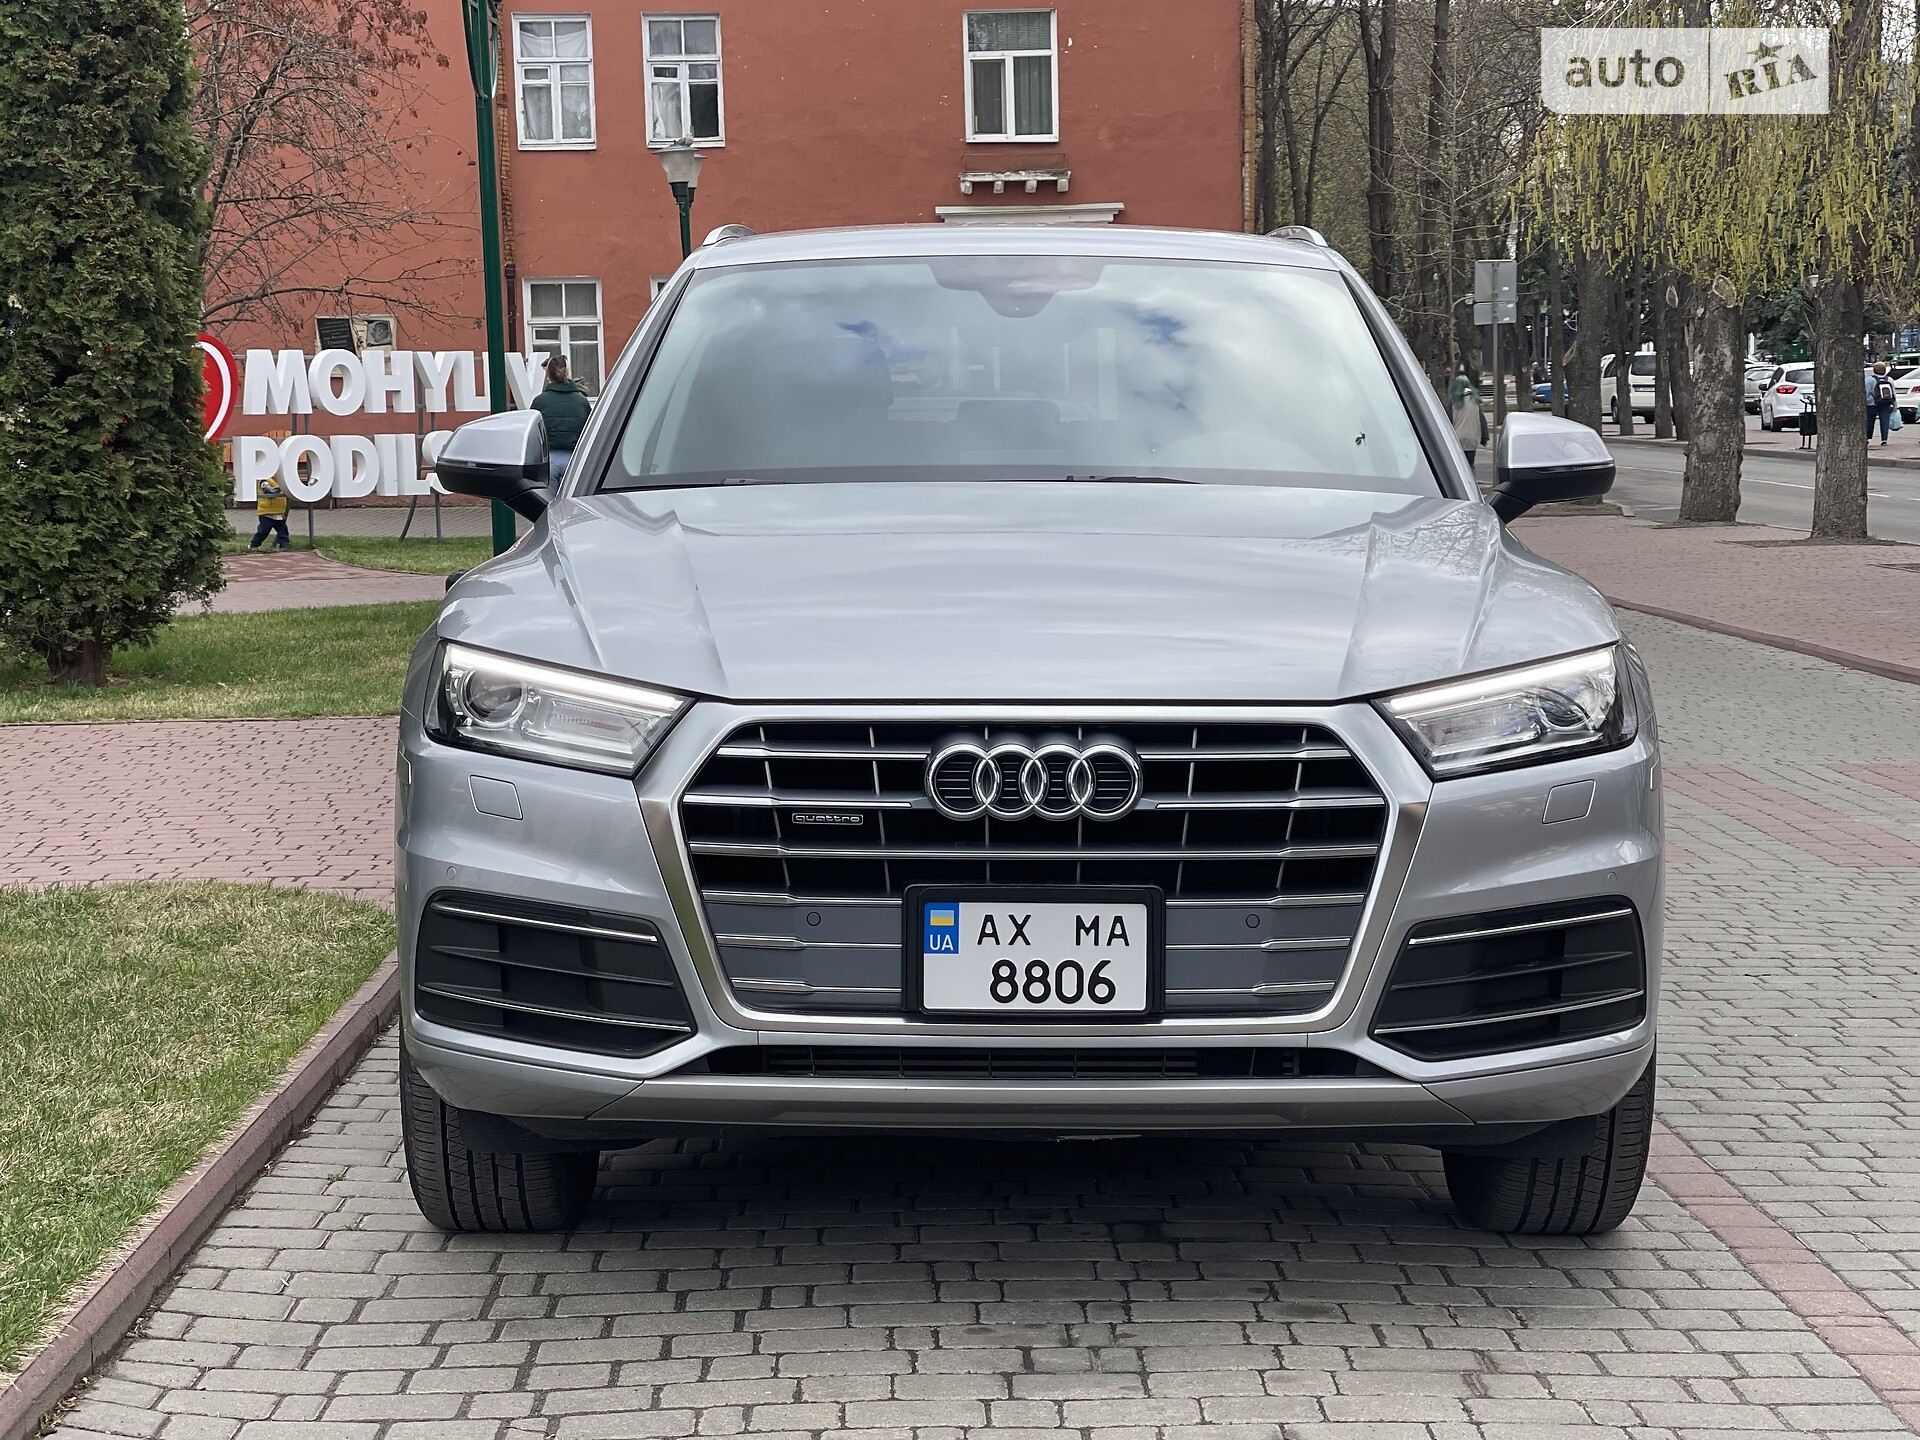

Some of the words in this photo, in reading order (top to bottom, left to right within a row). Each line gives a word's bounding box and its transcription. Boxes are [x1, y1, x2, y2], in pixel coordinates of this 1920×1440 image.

[243, 349, 551, 415] MOHYLV
[795, 814, 860, 823] quattro
[929, 934, 954, 951] UA
[977, 914, 1031, 946] AX
[1075, 915, 1130, 947] MA
[989, 959, 1117, 1004] 8806
